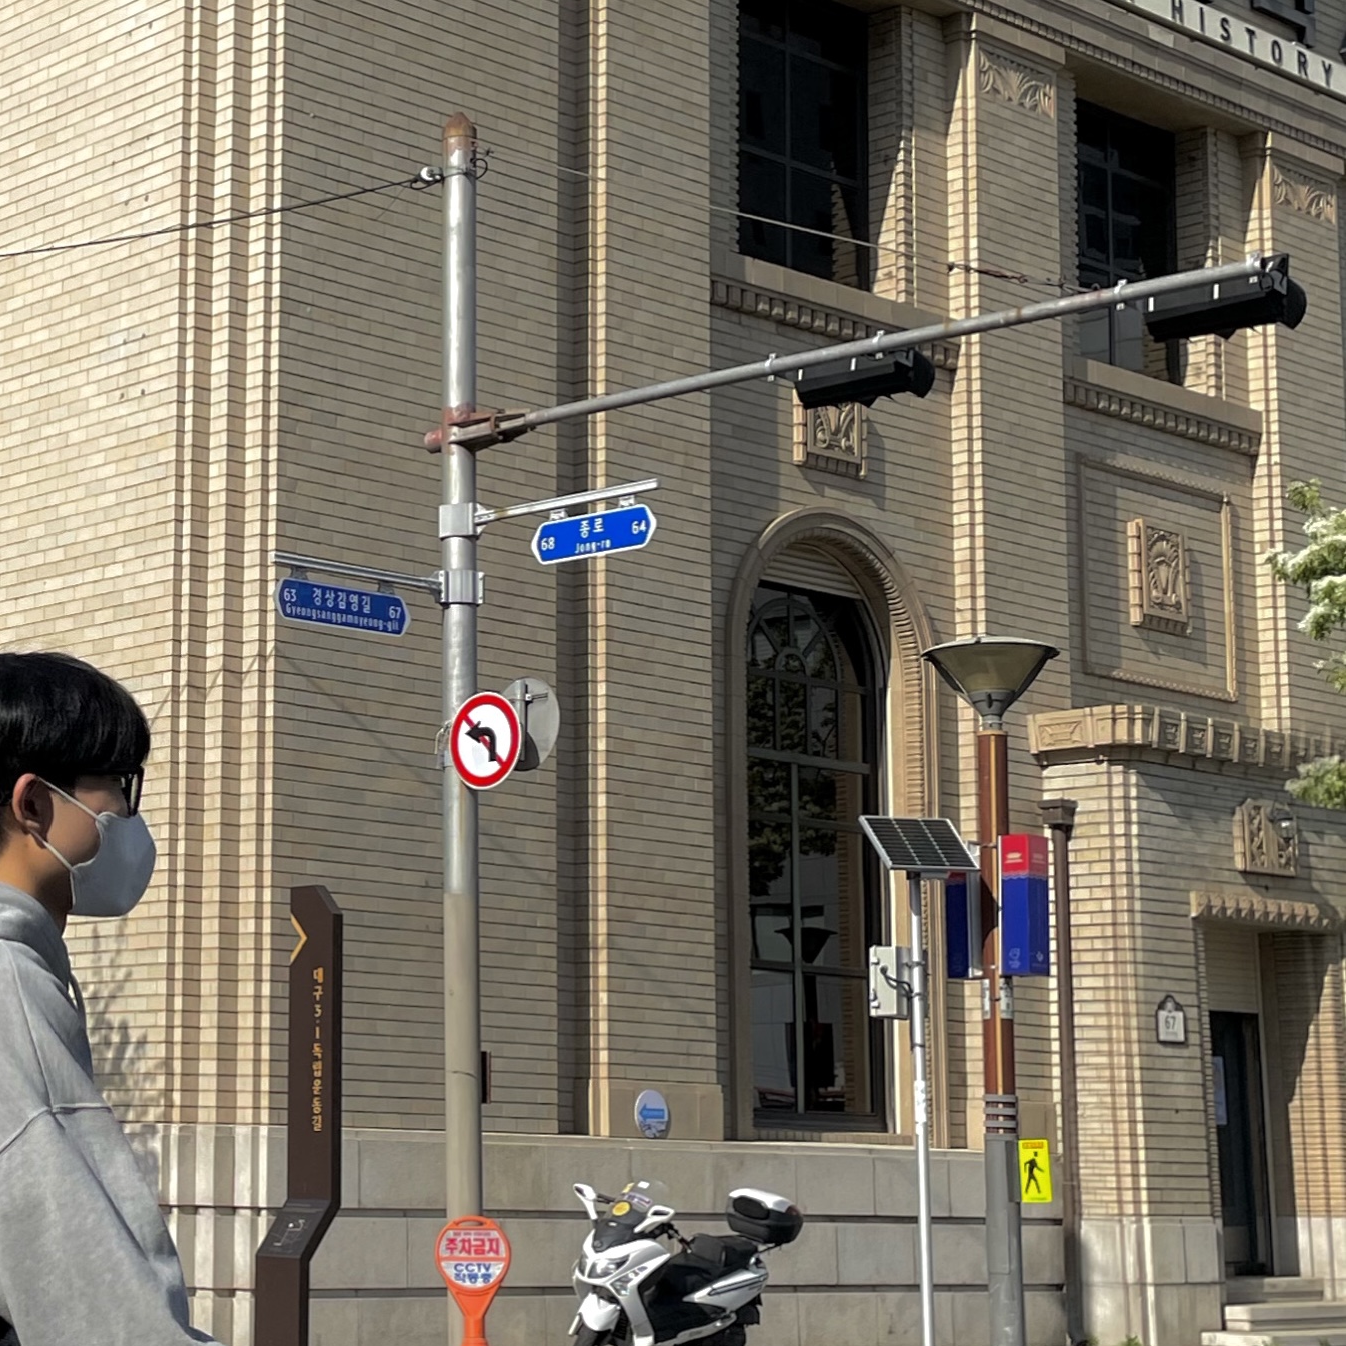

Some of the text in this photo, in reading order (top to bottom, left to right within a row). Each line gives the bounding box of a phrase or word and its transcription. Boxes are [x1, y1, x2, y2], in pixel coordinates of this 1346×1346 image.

[1170, 0, 1333, 90] HISTORY
[540, 518, 648, 551] 68 종로 64
[574, 539, 612, 554] Jong-ro
[283, 587, 402, 619] 63 경상감영길 67
[445, 1237, 500, 1256] 주차금지
[453, 1263, 492, 1273] CCTV
